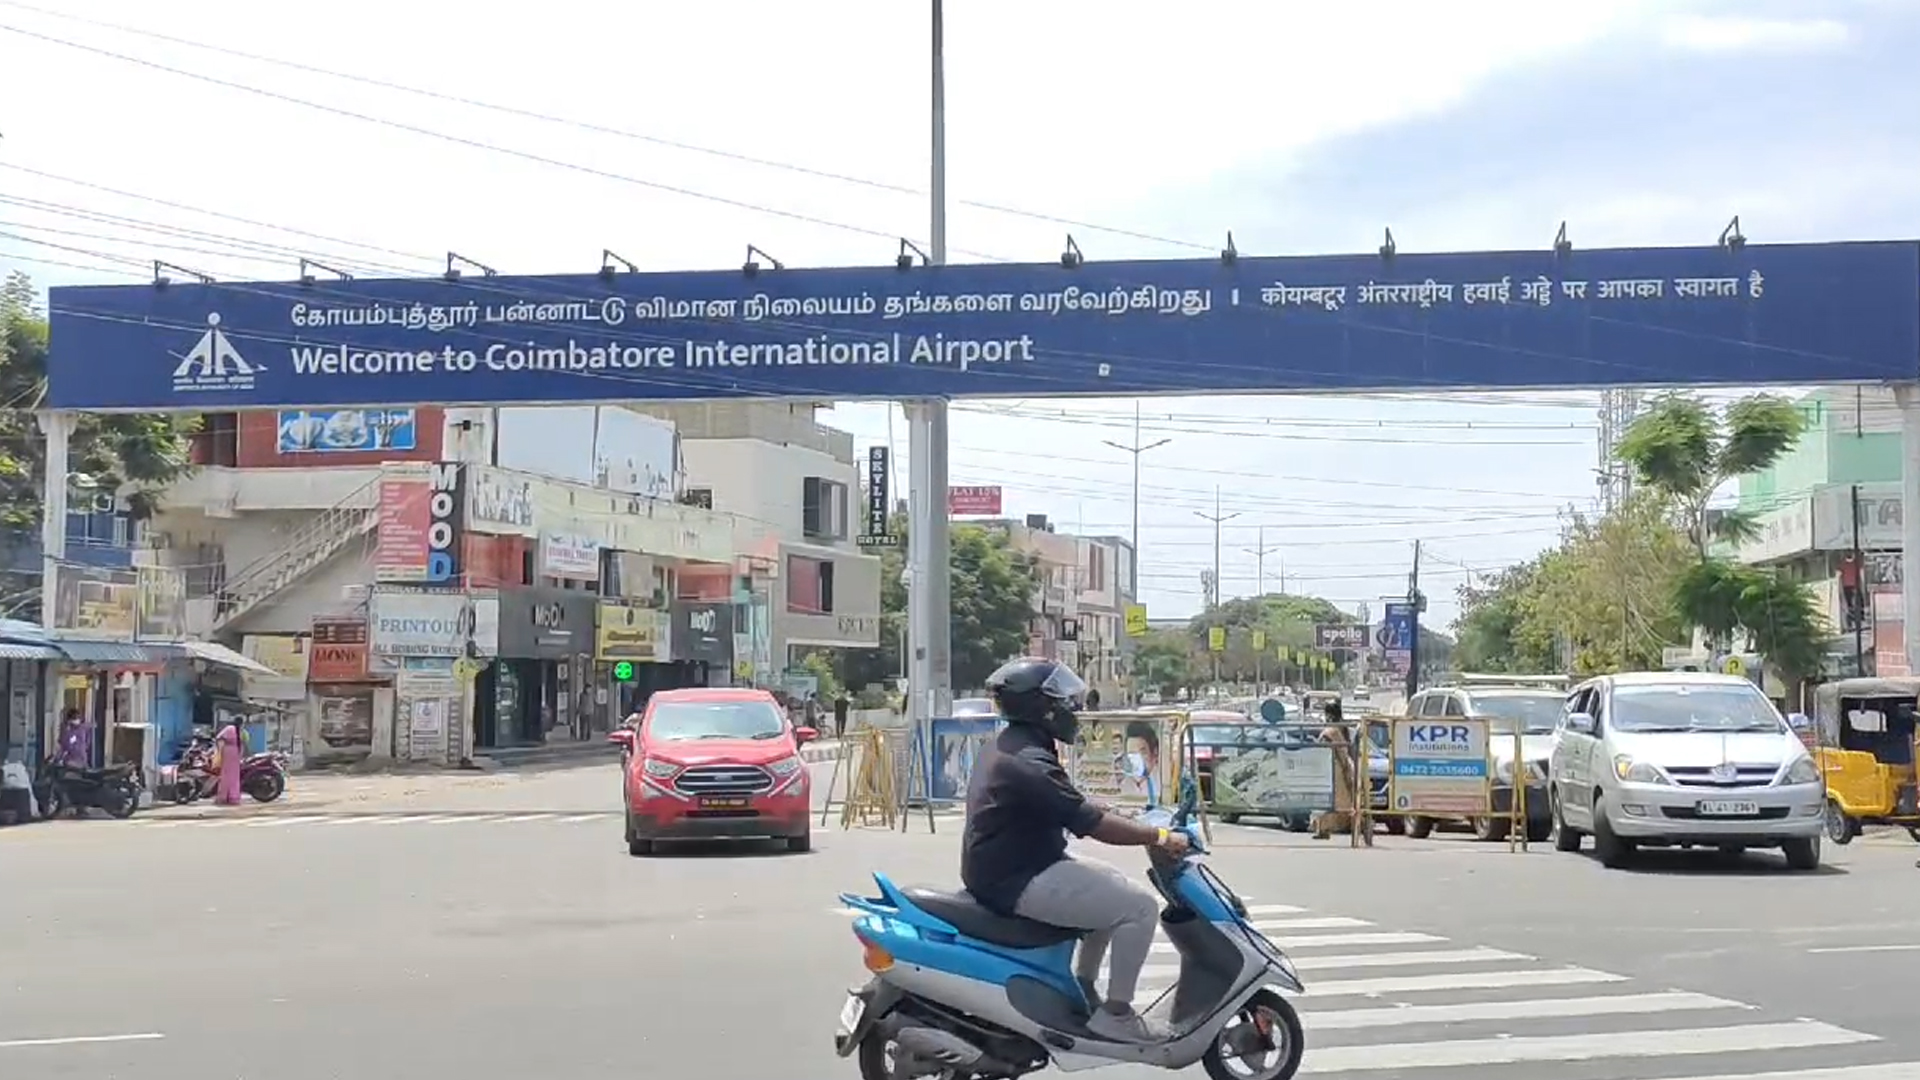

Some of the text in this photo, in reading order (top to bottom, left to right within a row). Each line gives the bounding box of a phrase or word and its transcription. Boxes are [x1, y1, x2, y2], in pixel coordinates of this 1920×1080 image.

[291, 285, 1211, 331] கோயம்புத்தூர் பன்னாட்டு விமான நிலையம் தங்களை வரவேற்கிறது
[1261, 270, 1764, 310] कोयम्बटूर अंतरराष्ट्रीय हवाई अड्डे पर आपका स्वागत है
[291, 333, 1034, 374] Welcome to Coimbatore International Airport
[871, 449, 884, 534] SKYLITE
[428, 463, 458, 581] MOOD
[1321, 626, 1363, 643] apollo
[1409, 725, 1469, 742] KPR
[1409, 743, 1470, 752] Institutions
